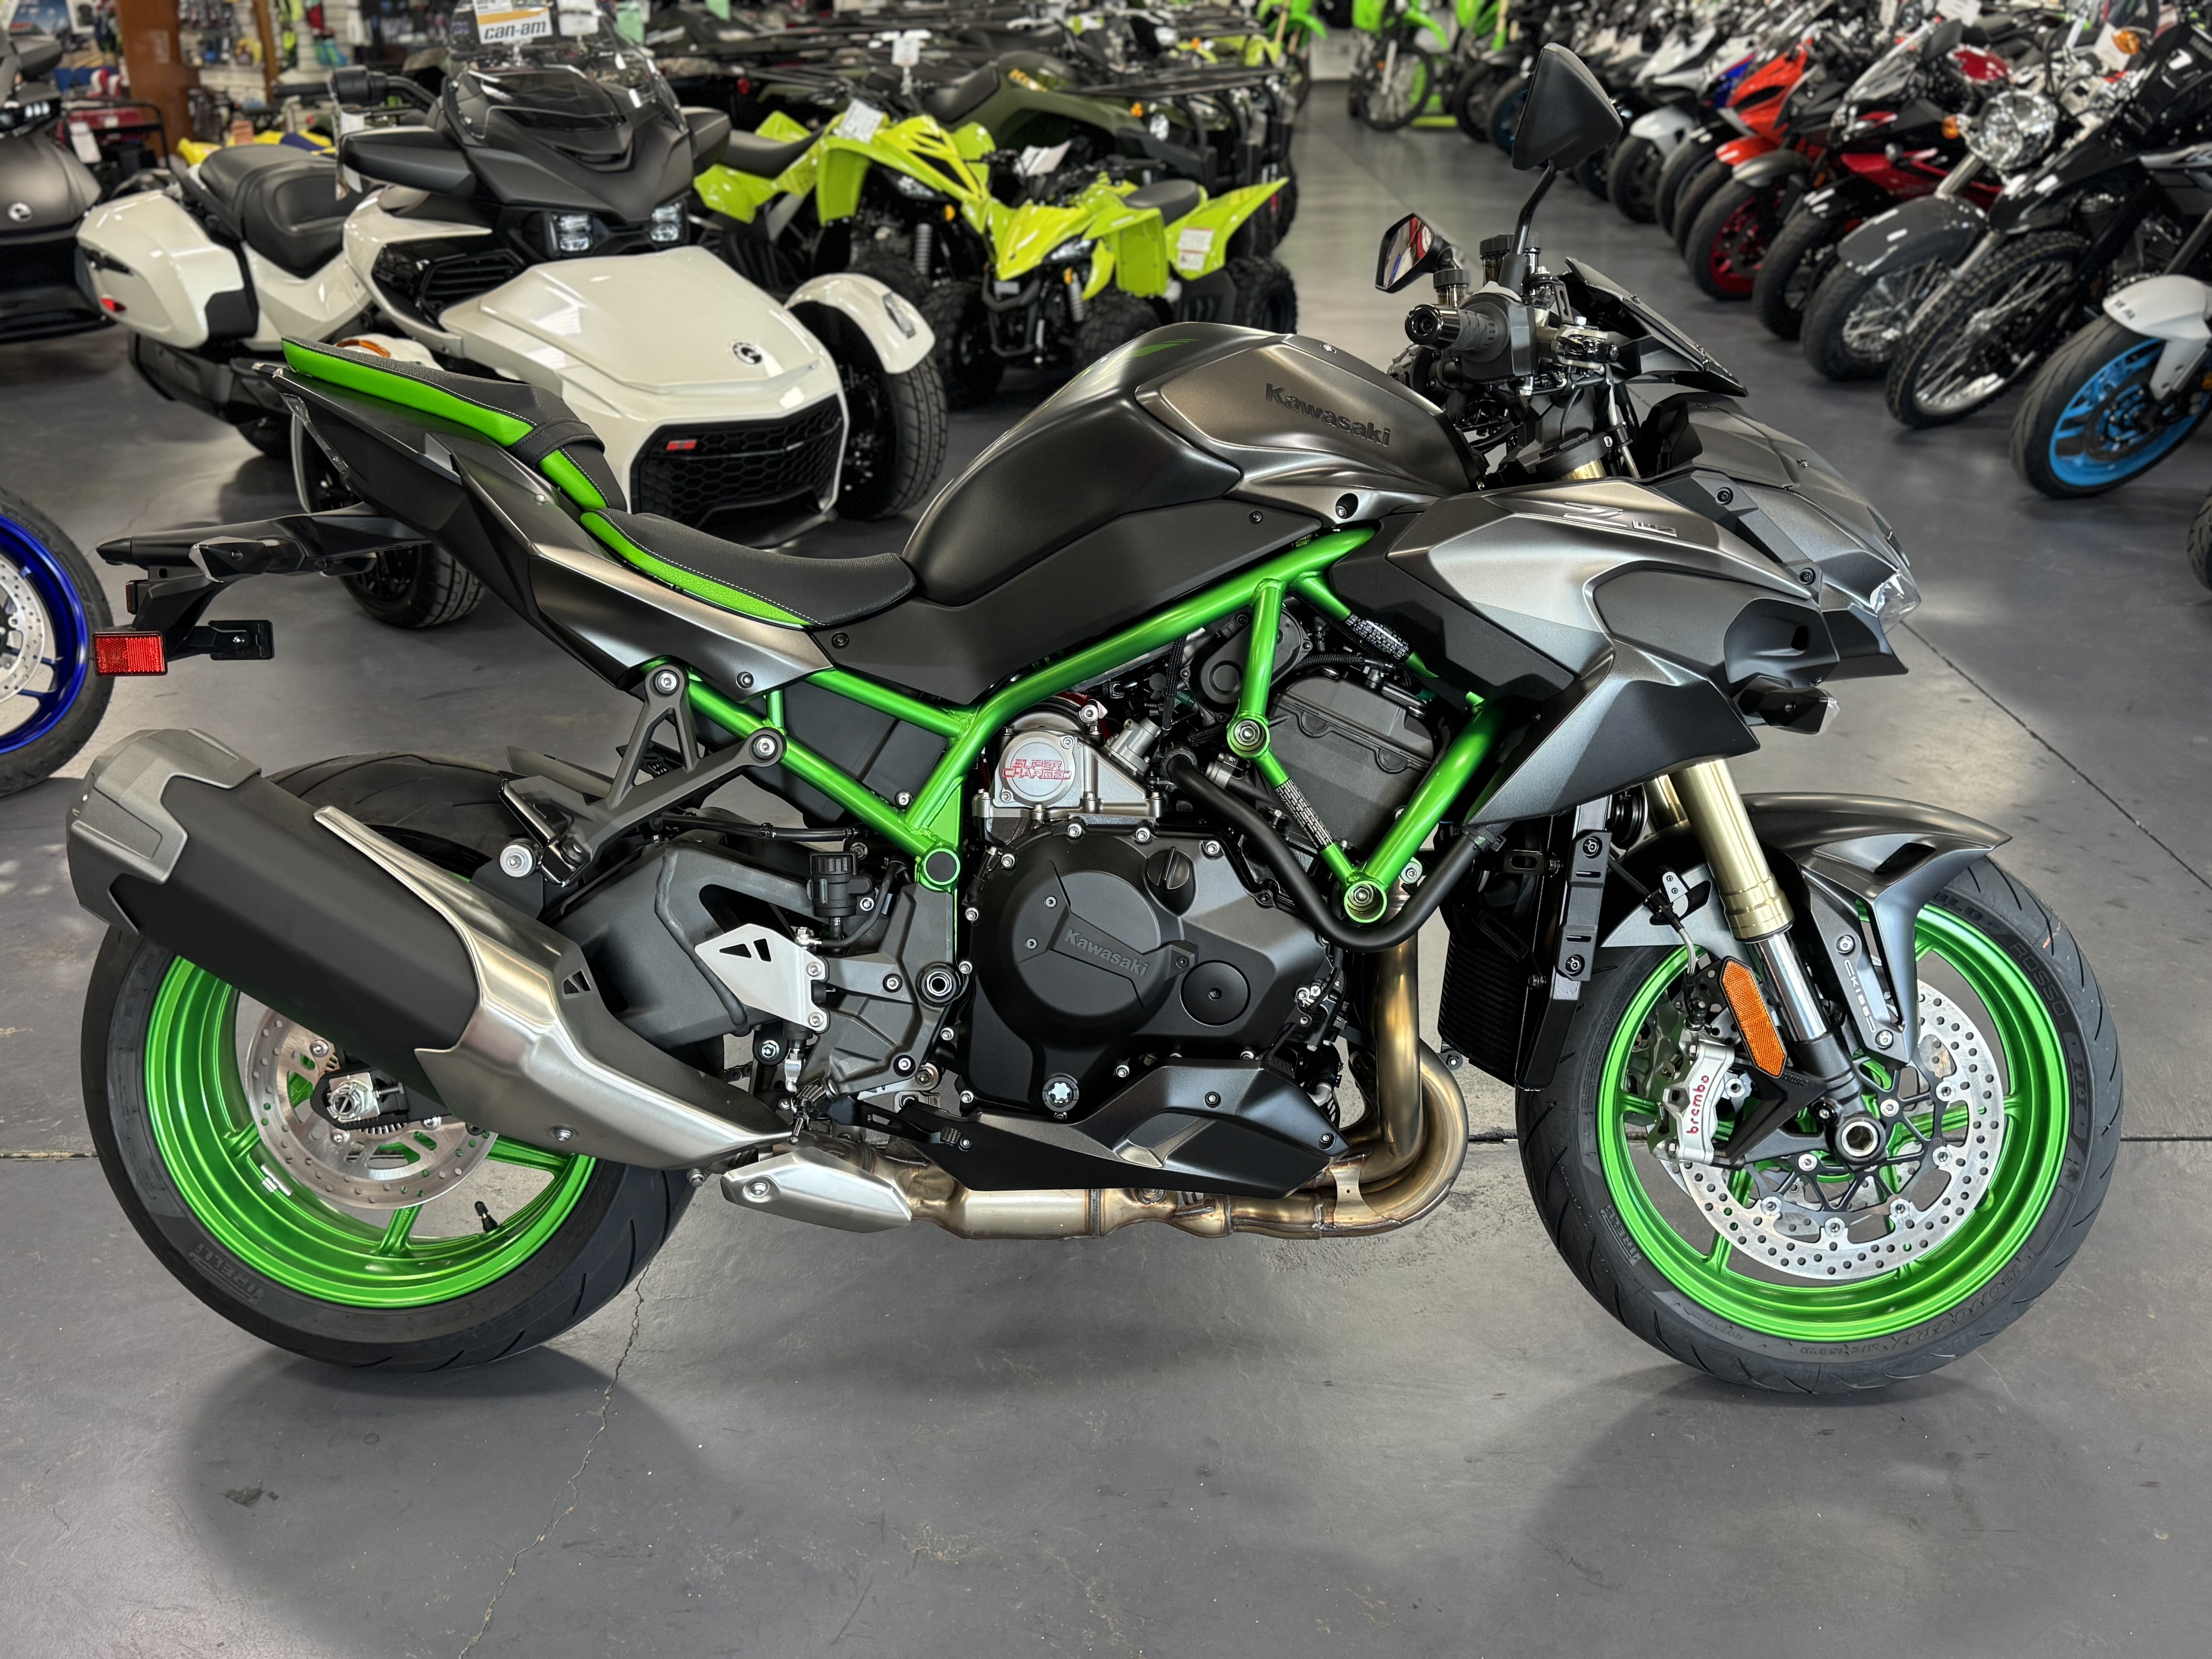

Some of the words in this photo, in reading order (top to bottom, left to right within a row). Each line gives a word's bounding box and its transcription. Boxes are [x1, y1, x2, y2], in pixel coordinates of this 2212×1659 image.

[484, 21, 546, 40] can-am
[1266, 383, 1391, 448] Kawasaki
[1002, 768, 1072, 780] CHARGED
[1013, 759, 1062, 770] SUPER
[1065, 929, 1149, 977] Kawasaki
[2009, 940, 2068, 1017] ROSSO
[1686, 1075, 1710, 1135] brembo
[1599, 1204, 1643, 1266] PIRELLI
[188, 1242, 266, 1307] PIRELLI
